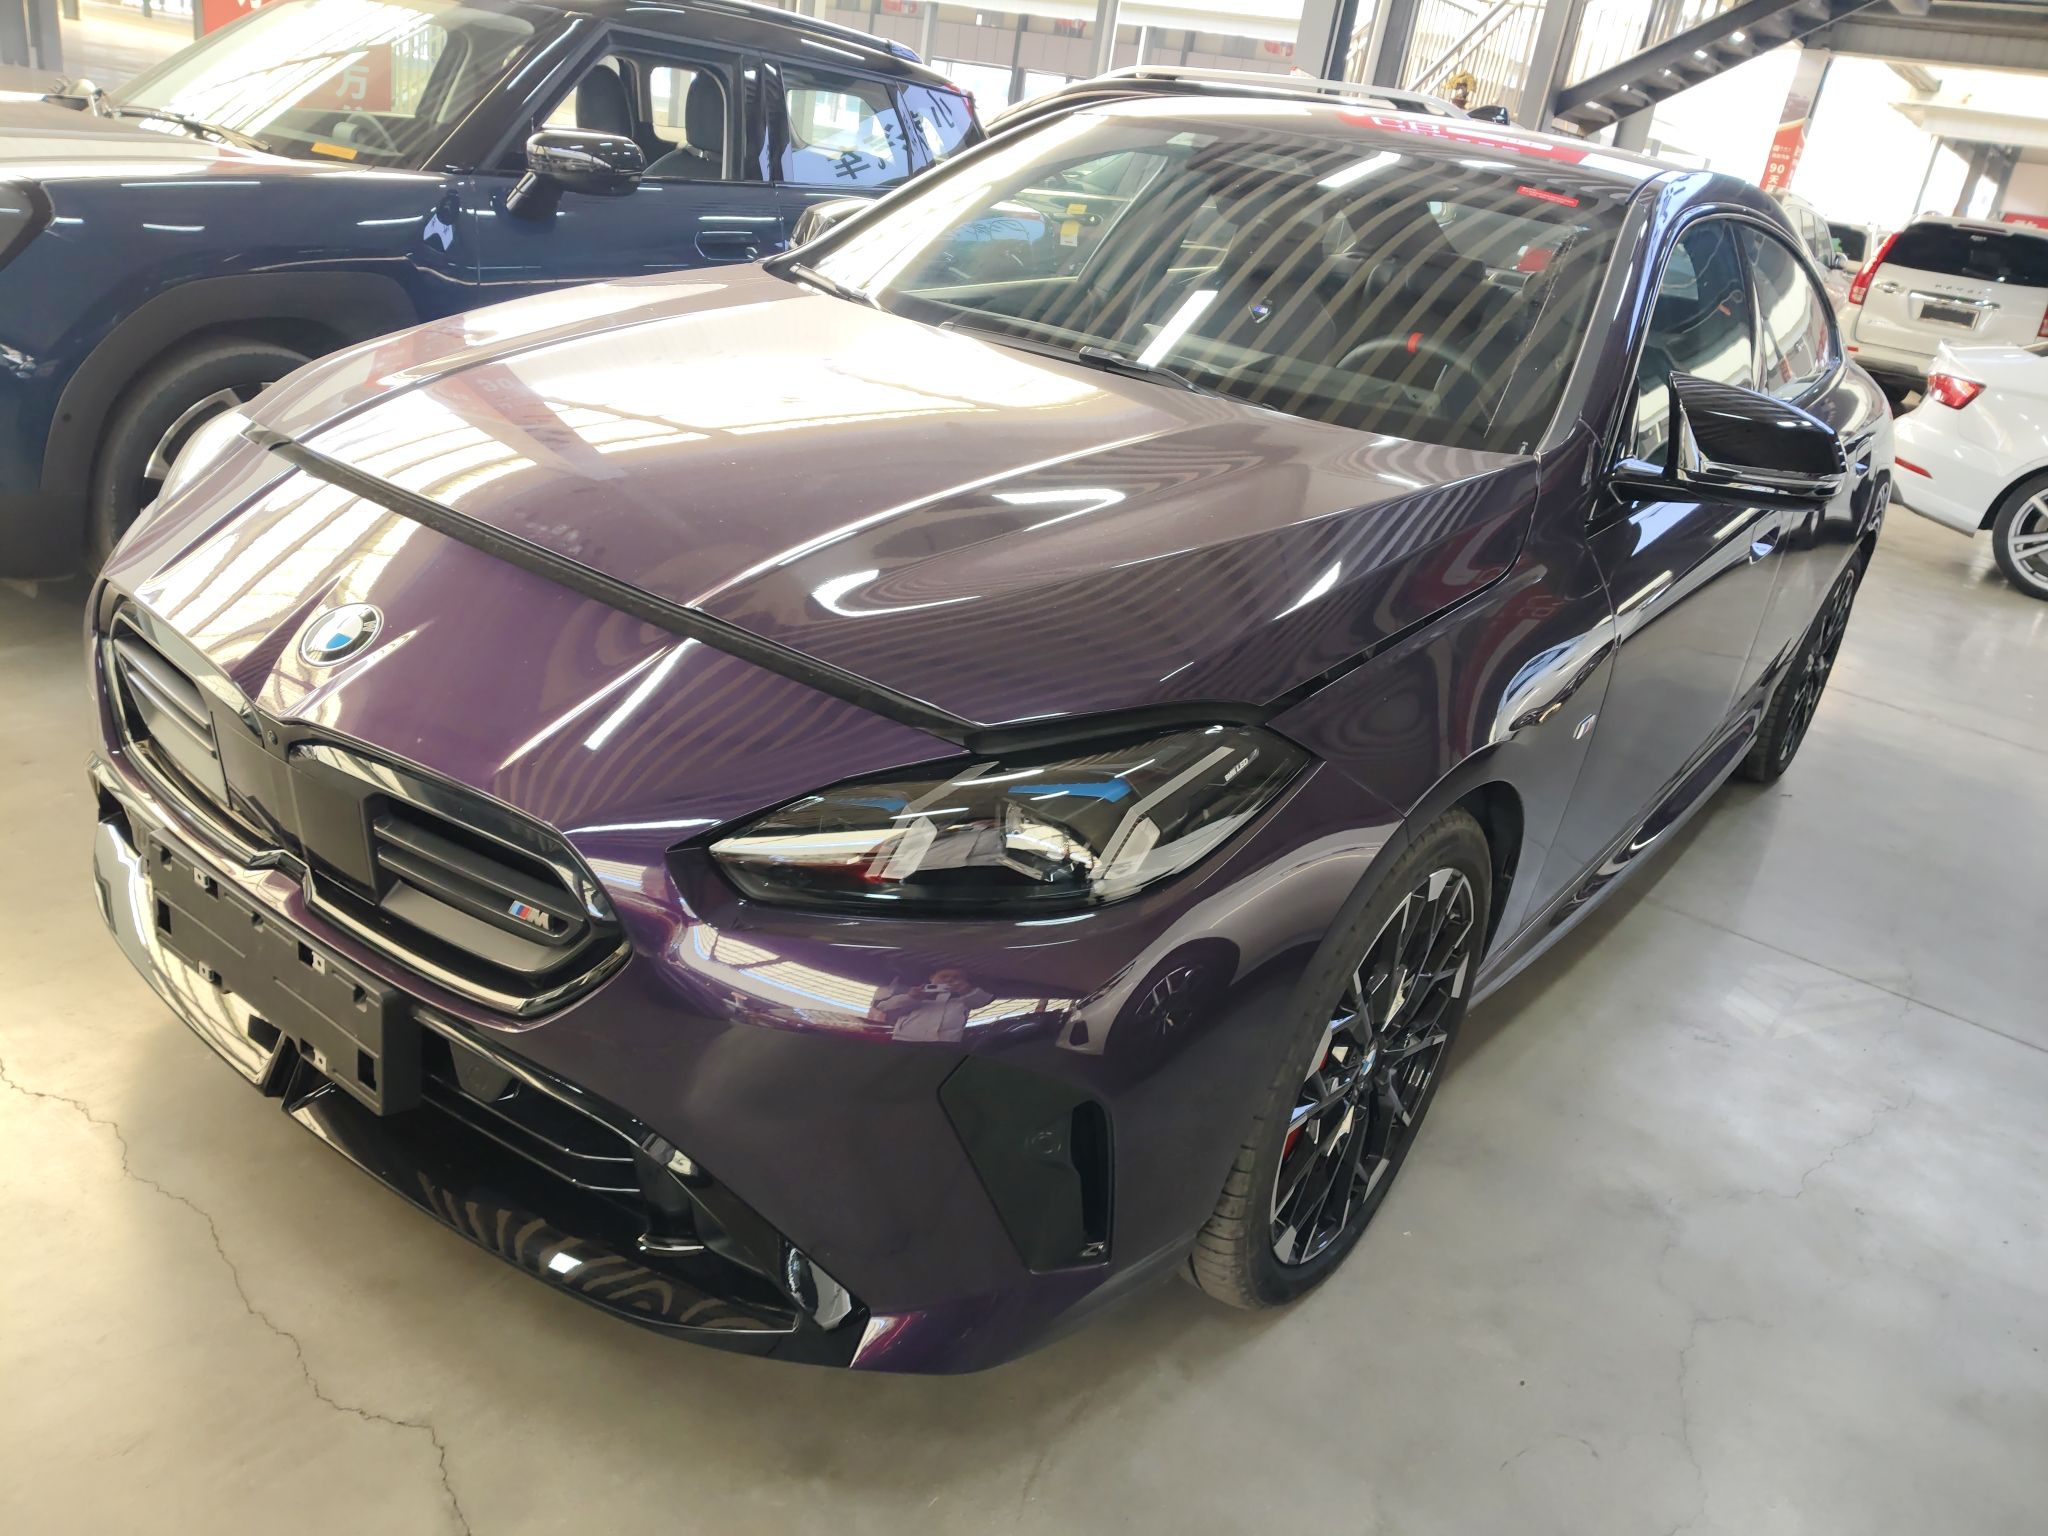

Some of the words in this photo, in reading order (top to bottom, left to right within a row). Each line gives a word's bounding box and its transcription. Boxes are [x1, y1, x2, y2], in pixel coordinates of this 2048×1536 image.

[1769, 162, 1785, 175] 90
[1767, 174, 1780, 185] 天
[1236, 757, 1249, 773] LED
